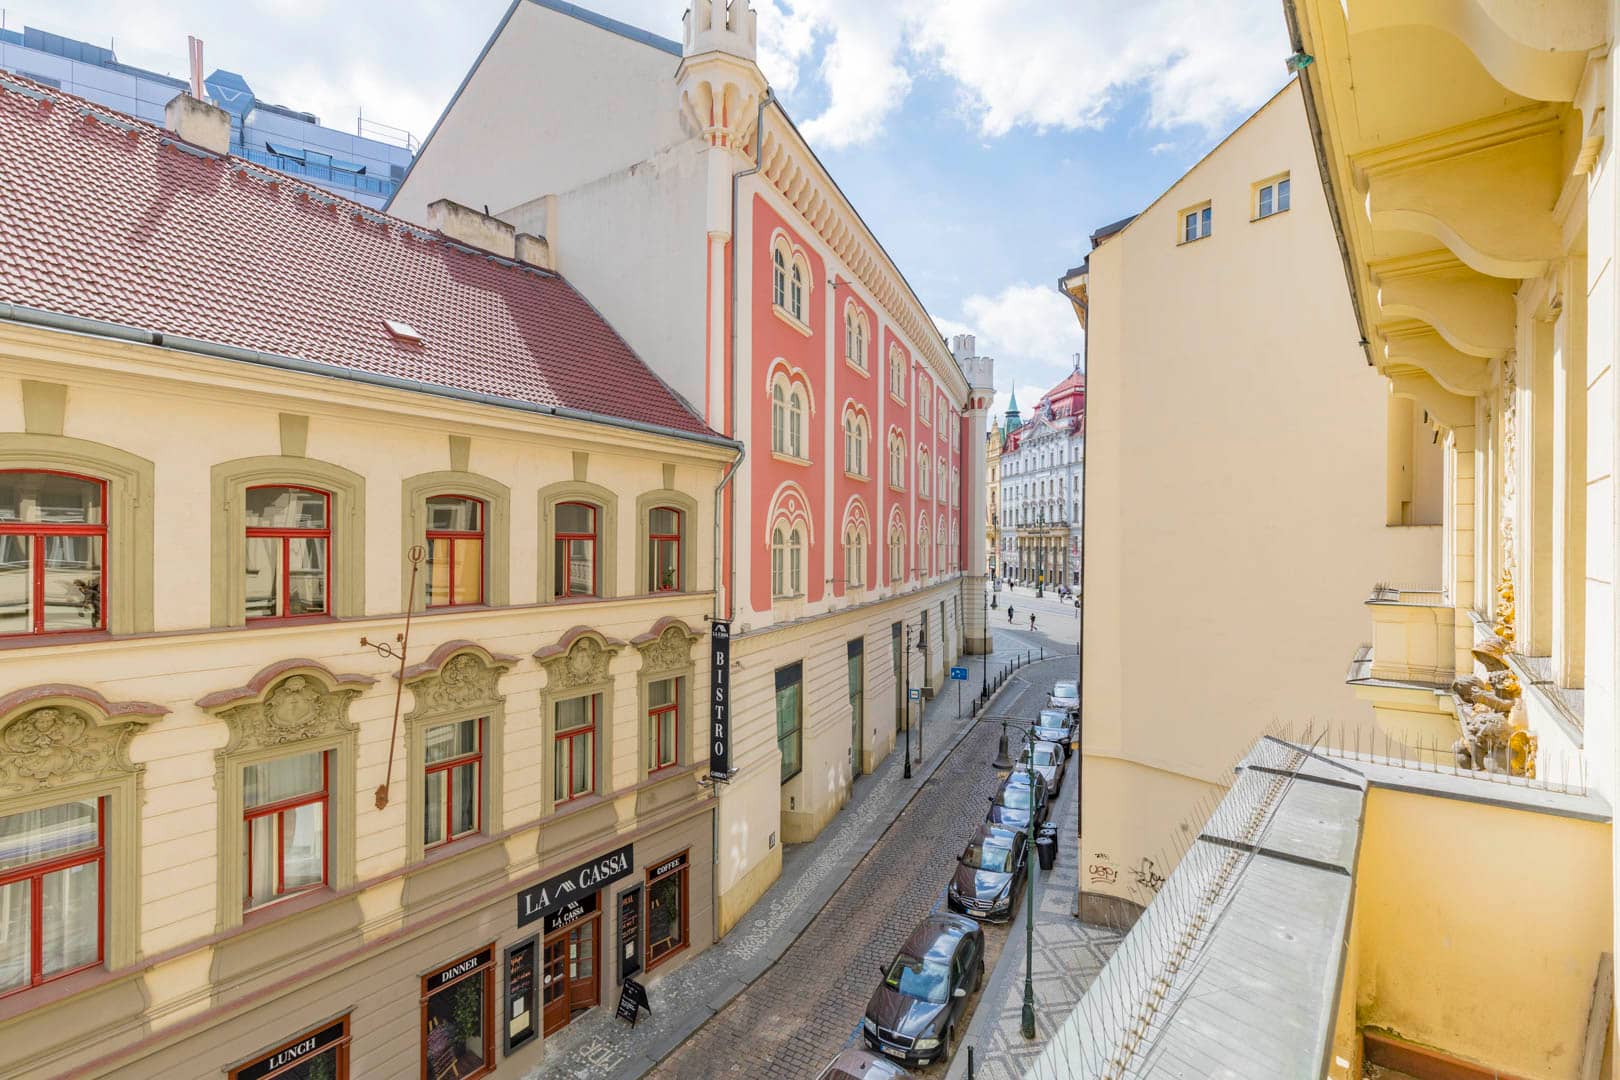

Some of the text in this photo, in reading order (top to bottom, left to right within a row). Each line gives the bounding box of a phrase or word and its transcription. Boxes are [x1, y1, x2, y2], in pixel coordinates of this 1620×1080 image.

[714, 651, 725, 757] BISTRO
[656, 858, 680, 875] COFFEE
[525, 852, 628, 916] LA CASSA
[552, 916, 563, 928] LA
[563, 906, 584, 922] CASSA
[441, 957, 478, 982] DINNER
[268, 1037, 316, 1071] LUNCH
